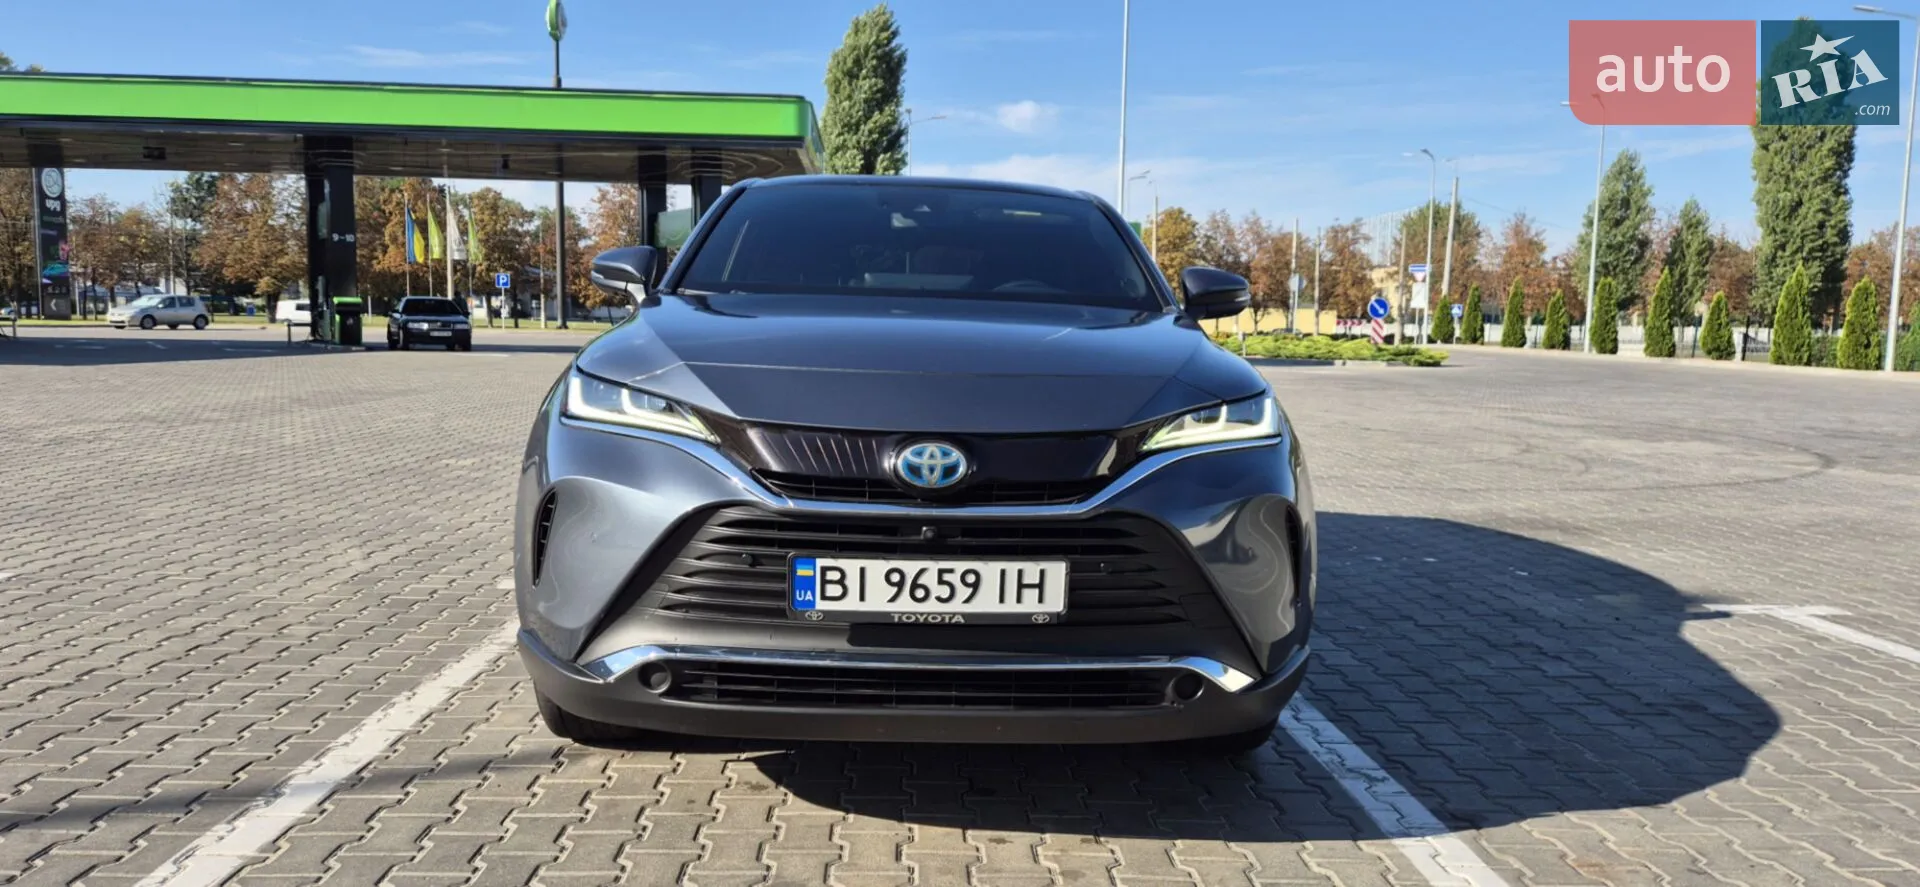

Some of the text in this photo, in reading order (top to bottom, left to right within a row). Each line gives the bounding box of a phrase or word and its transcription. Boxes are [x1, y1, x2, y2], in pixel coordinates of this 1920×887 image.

[499, 275, 508, 287] P
[820, 566, 1046, 604] BI 9659 IH
[796, 589, 814, 601] UA
[891, 613, 965, 624] TOYOTA
